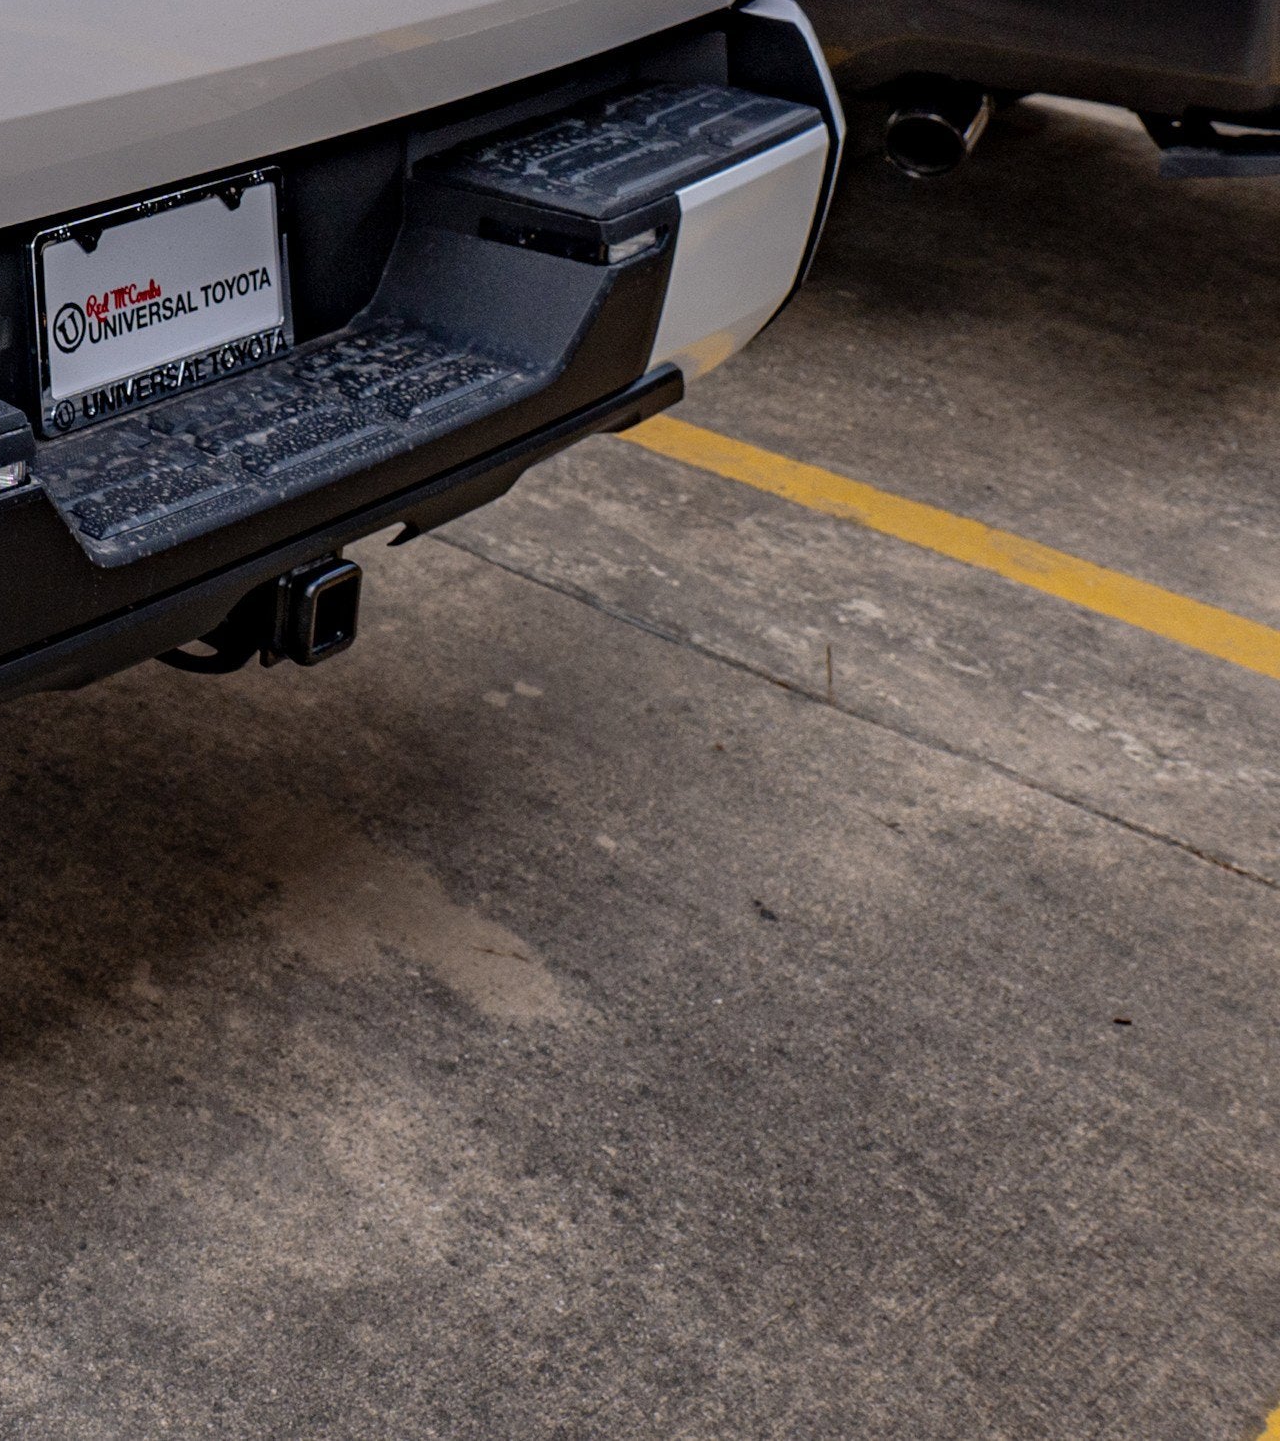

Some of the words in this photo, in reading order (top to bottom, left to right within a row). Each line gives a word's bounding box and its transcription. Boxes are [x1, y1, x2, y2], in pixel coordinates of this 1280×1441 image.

[86, 292, 110, 323] Red
[88, 290, 198, 344] UNIVERSAL
[201, 267, 272, 308] TOYOTA
[82, 359, 209, 419] UNIVERSAL
[208, 329, 289, 379] TOYOTA
